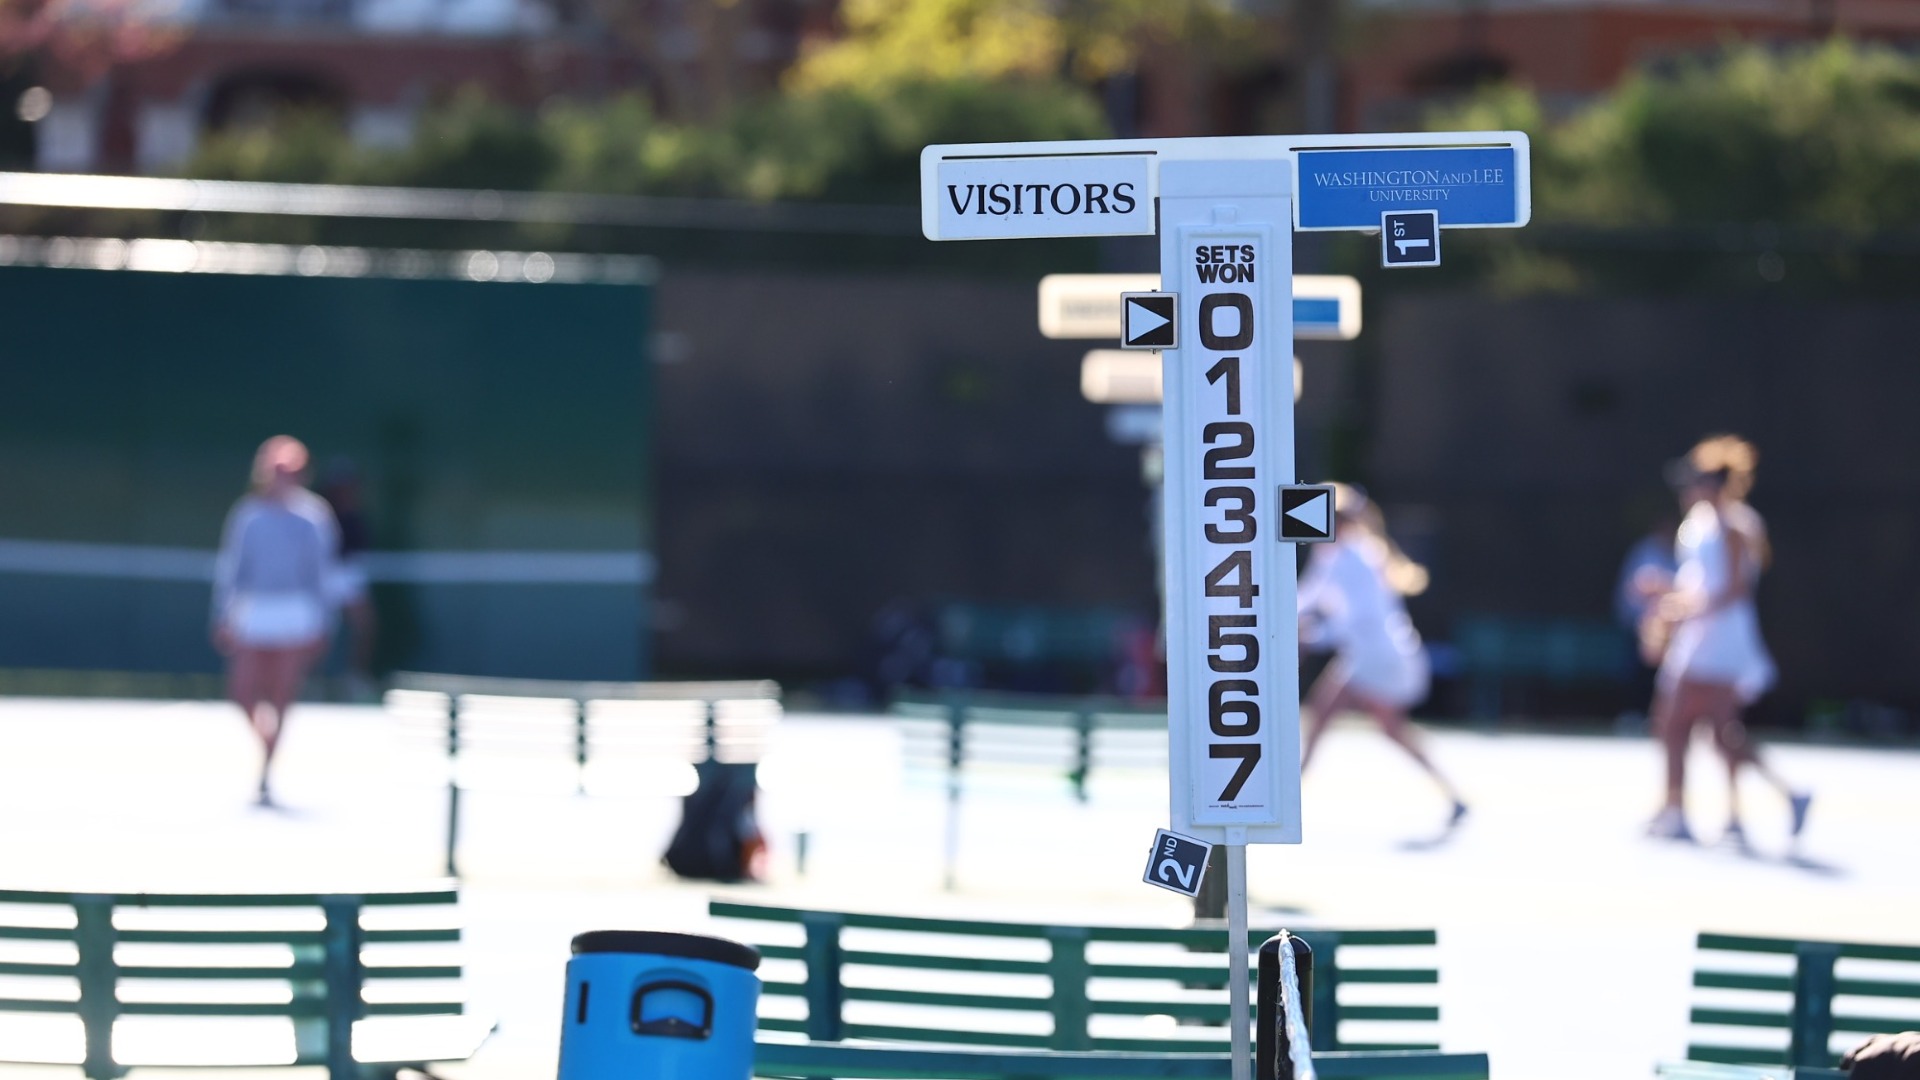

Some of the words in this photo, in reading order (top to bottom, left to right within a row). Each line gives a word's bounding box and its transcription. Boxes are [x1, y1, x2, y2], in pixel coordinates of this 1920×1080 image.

[947, 182, 1136, 215] VISITORS
[1314, 170, 1439, 187] WASHINGTON
[1442, 172, 1471, 184] AND
[1473, 168, 1504, 184] LEE
[1370, 189, 1450, 202] UNIVERSITY
[1195, 245, 1255, 264] SETS
[1196, 263, 1255, 284] WON
[1198, 292, 1254, 351] 0
[1205, 357, 1241, 415] 1
[1203, 421, 1255, 480] 2
[1204, 486, 1257, 544] 3
[1205, 550, 1259, 608] 4
[1207, 614, 1260, 673] 5
[1208, 679, 1260, 737] 6
[1209, 743, 1261, 802] 7
